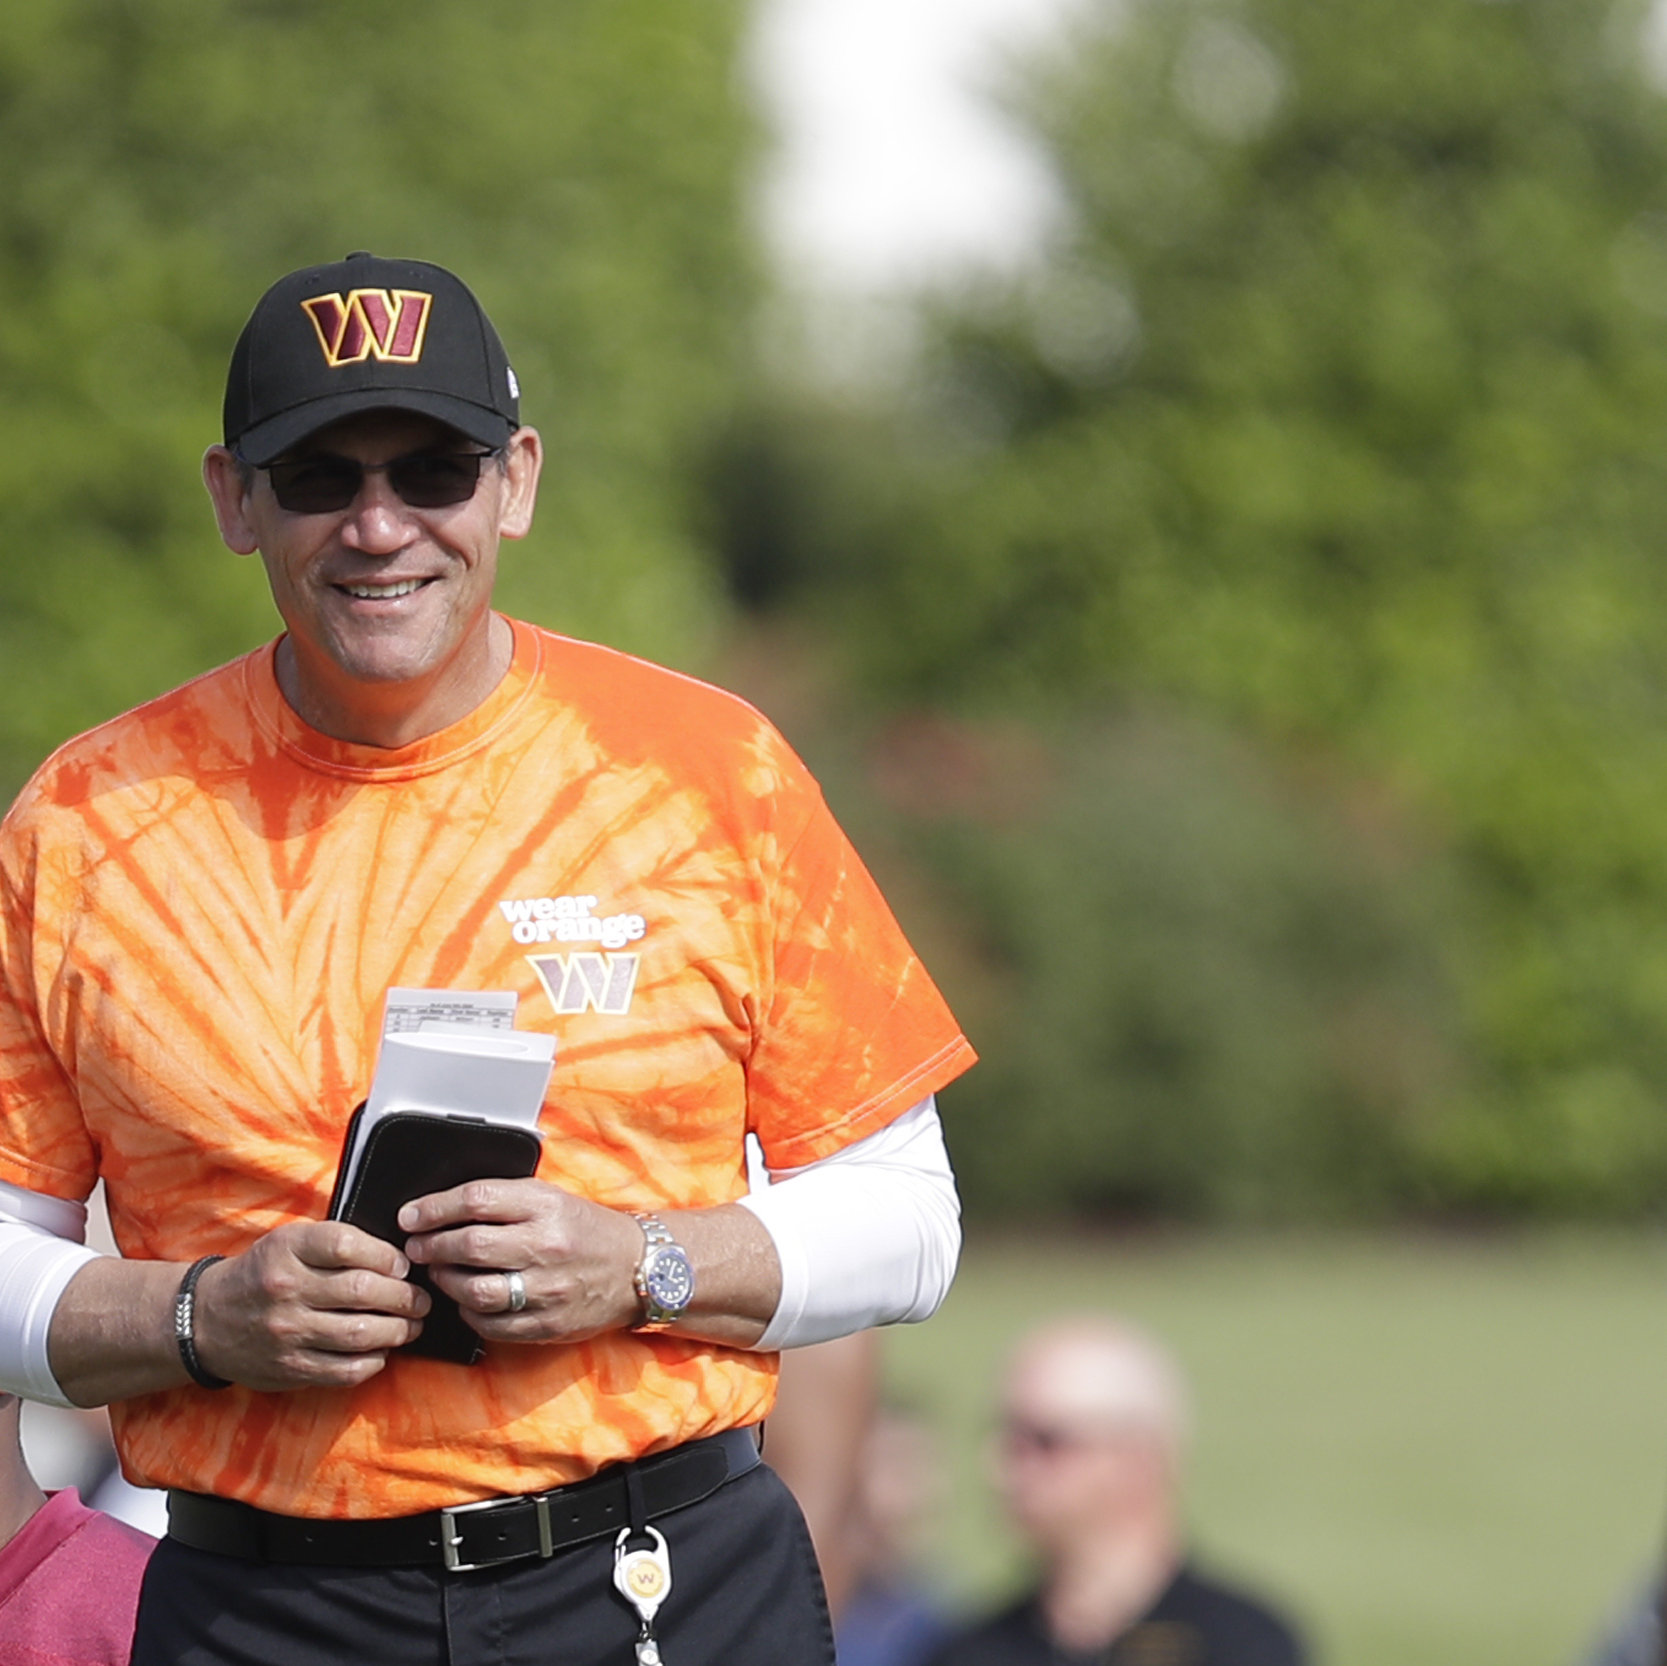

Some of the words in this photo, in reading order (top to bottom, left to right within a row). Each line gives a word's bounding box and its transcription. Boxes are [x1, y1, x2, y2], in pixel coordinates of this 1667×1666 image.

[301, 289, 433, 367] W
[499, 895, 598, 922] wear
[512, 914, 647, 949] orange
